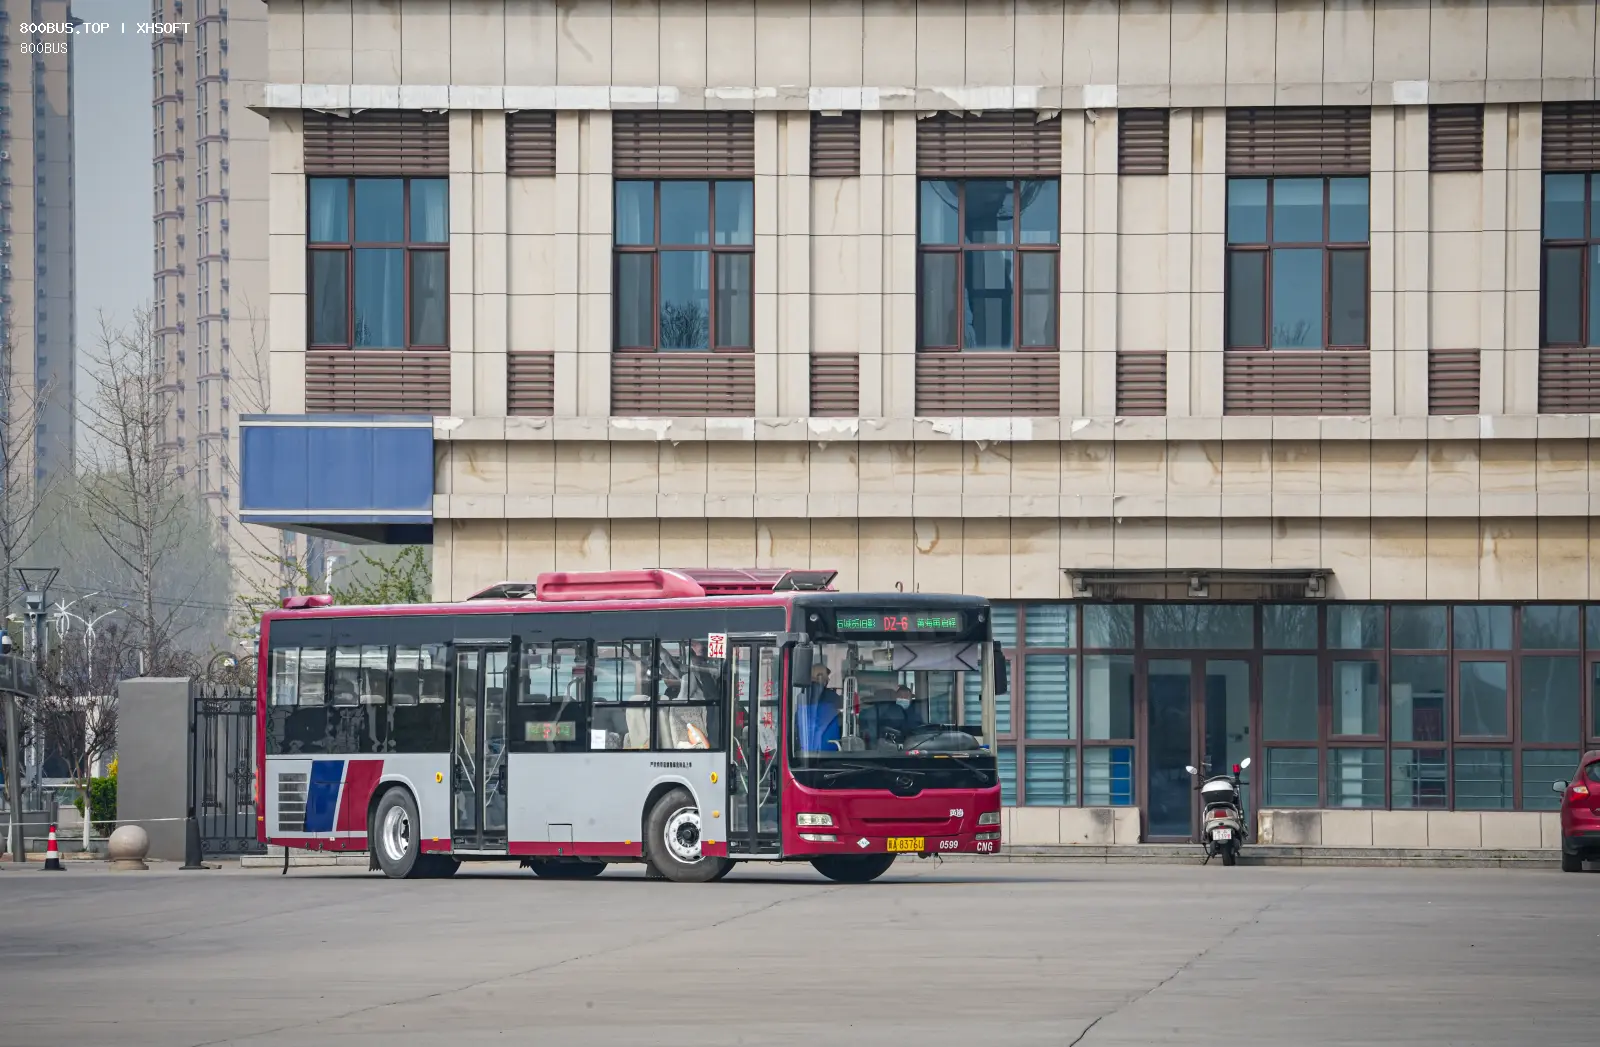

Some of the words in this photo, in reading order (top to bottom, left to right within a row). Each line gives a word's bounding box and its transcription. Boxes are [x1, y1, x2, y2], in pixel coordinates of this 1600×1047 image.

[883, 616, 909, 631] DZ-6
[709, 643, 723, 657] 344
[939, 840, 959, 849] 0599
[976, 842, 993, 852] CNG
